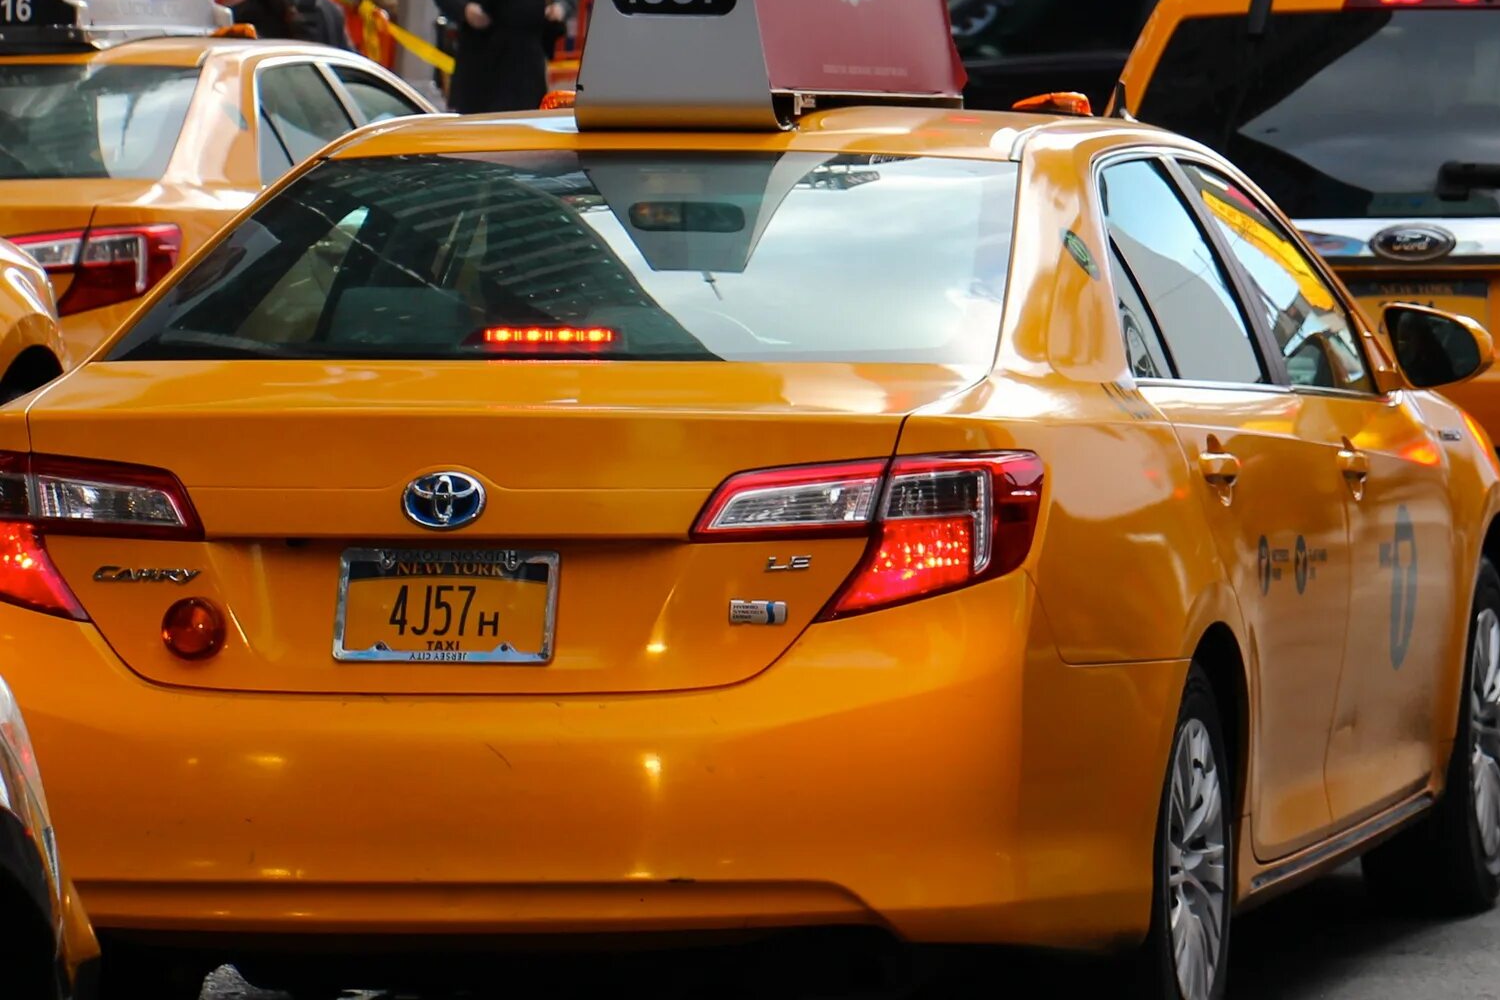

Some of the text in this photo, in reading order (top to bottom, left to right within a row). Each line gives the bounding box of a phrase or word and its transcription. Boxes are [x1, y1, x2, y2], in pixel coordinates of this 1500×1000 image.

[397, 561, 504, 577] NEW YORK
[764, 554, 813, 573] LE
[92, 565, 202, 586] CAMRY
[426, 640, 460, 652] TAXI
[408, 652, 469, 662] JERSEY CITY
